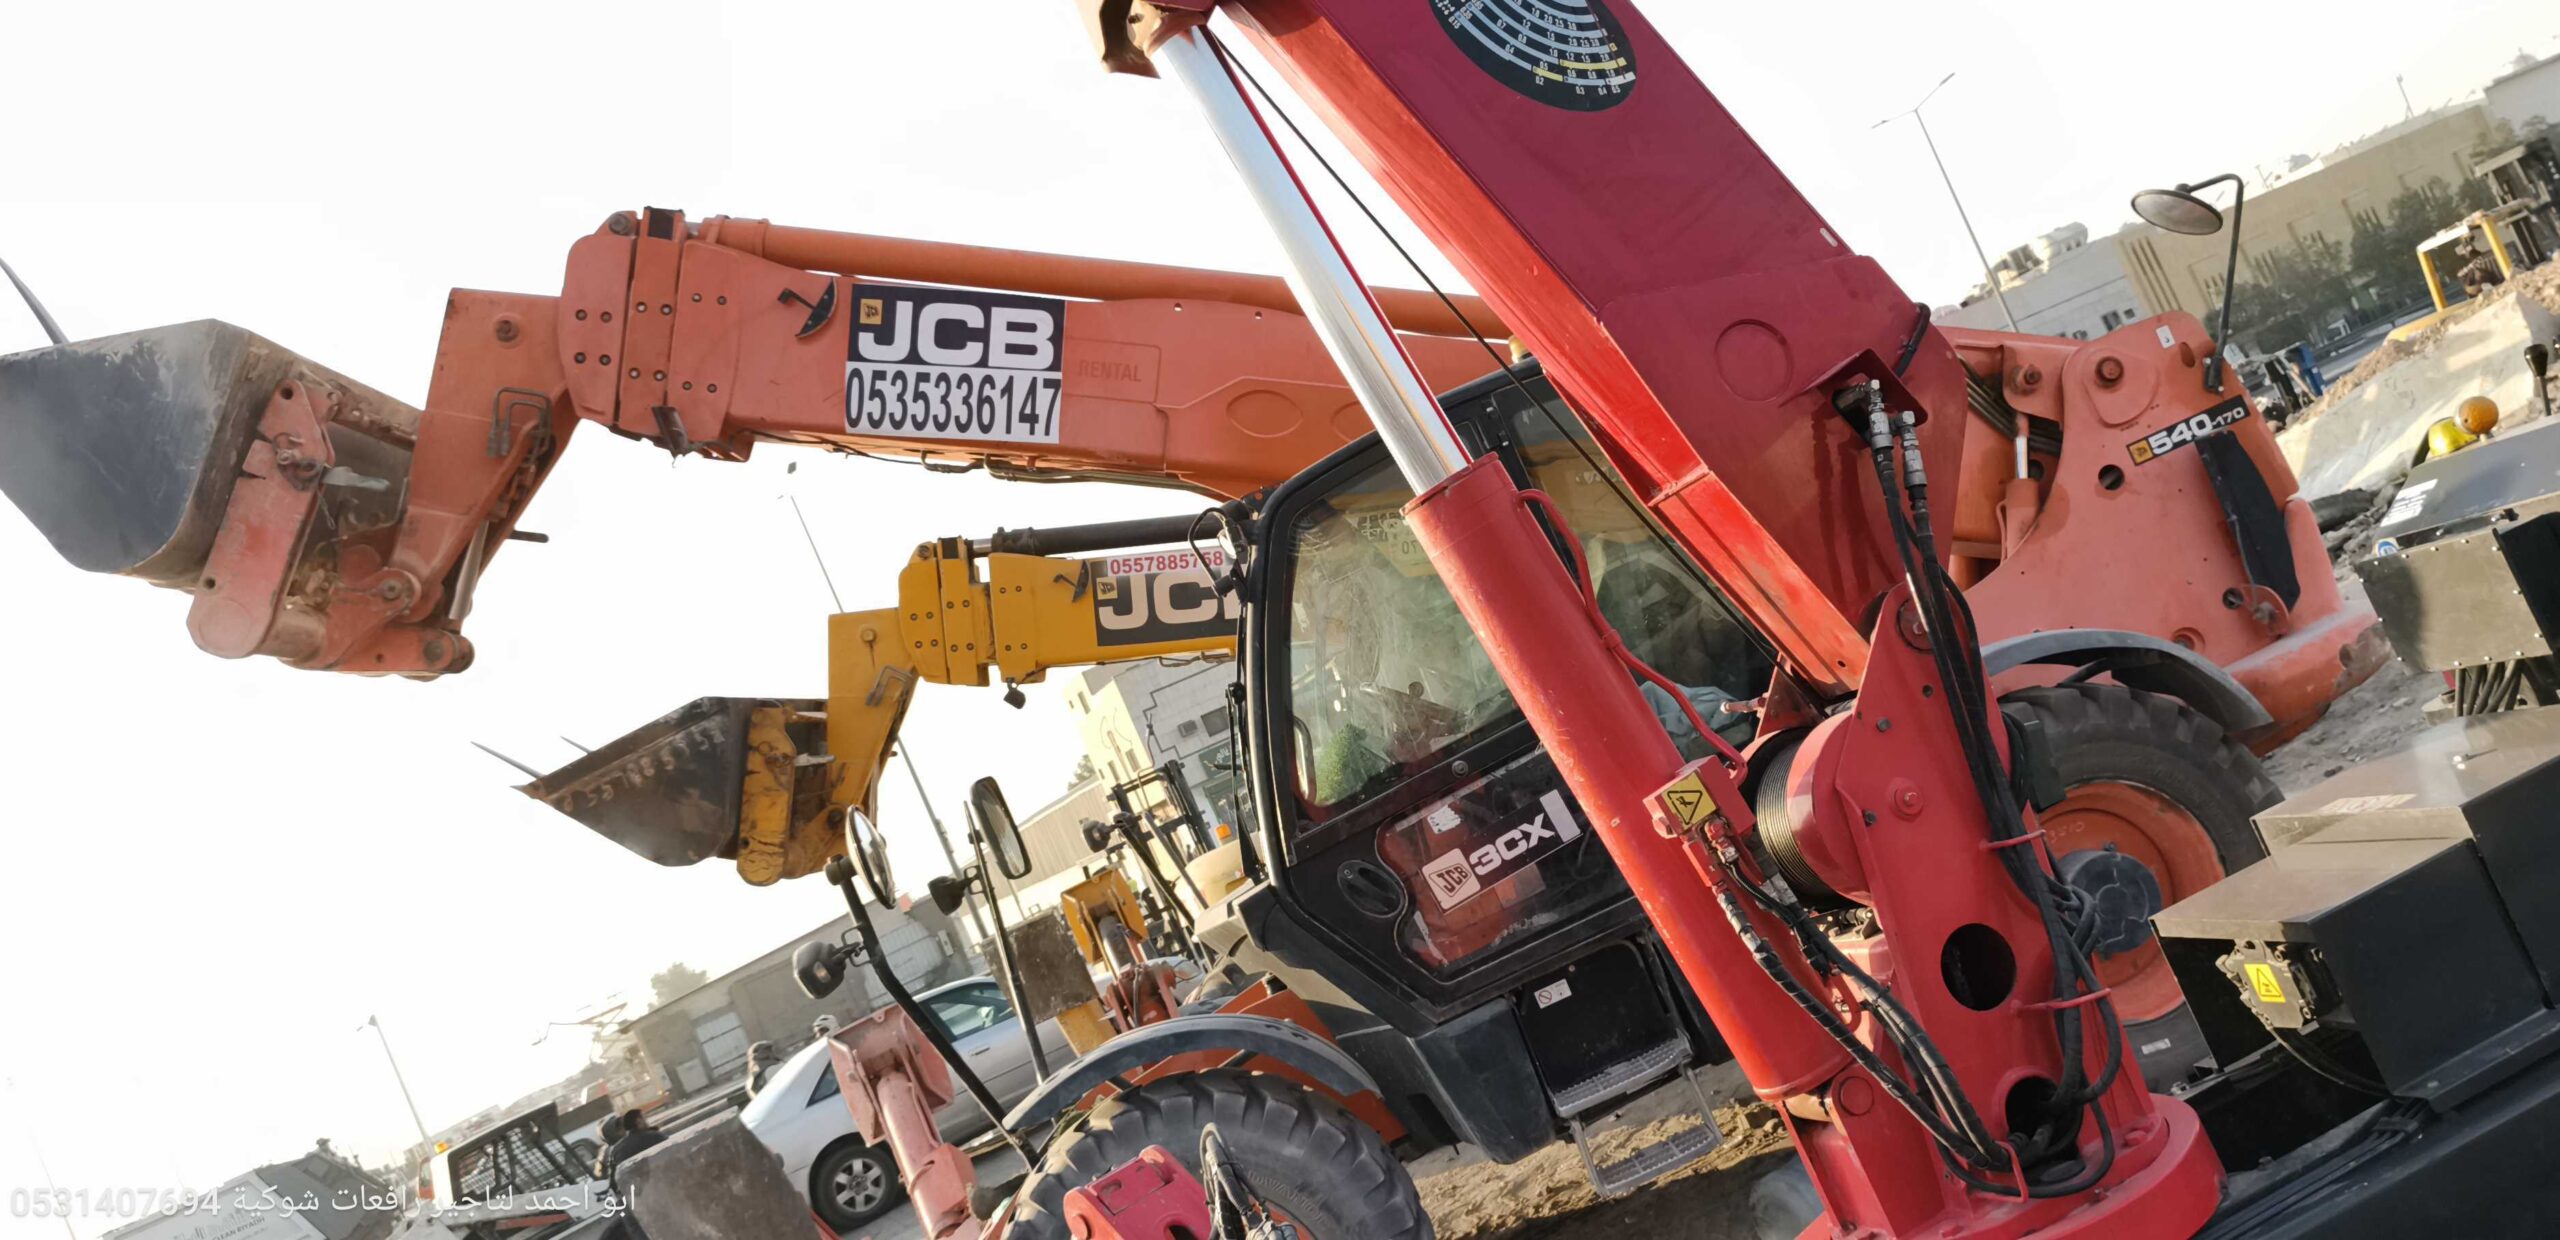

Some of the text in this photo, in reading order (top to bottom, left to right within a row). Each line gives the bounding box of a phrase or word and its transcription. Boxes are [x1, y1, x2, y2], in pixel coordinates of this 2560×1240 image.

[858, 301, 1055, 370] JCB
[1078, 359, 1142, 383] RENTAL
[846, 367, 1062, 437] 0535336147
[2147, 406, 2245, 455] 540-170
[1110, 551, 1224, 575] 0557885758
[1436, 865, 1469, 894] JCB
[1468, 813, 1556, 876] 3CX
